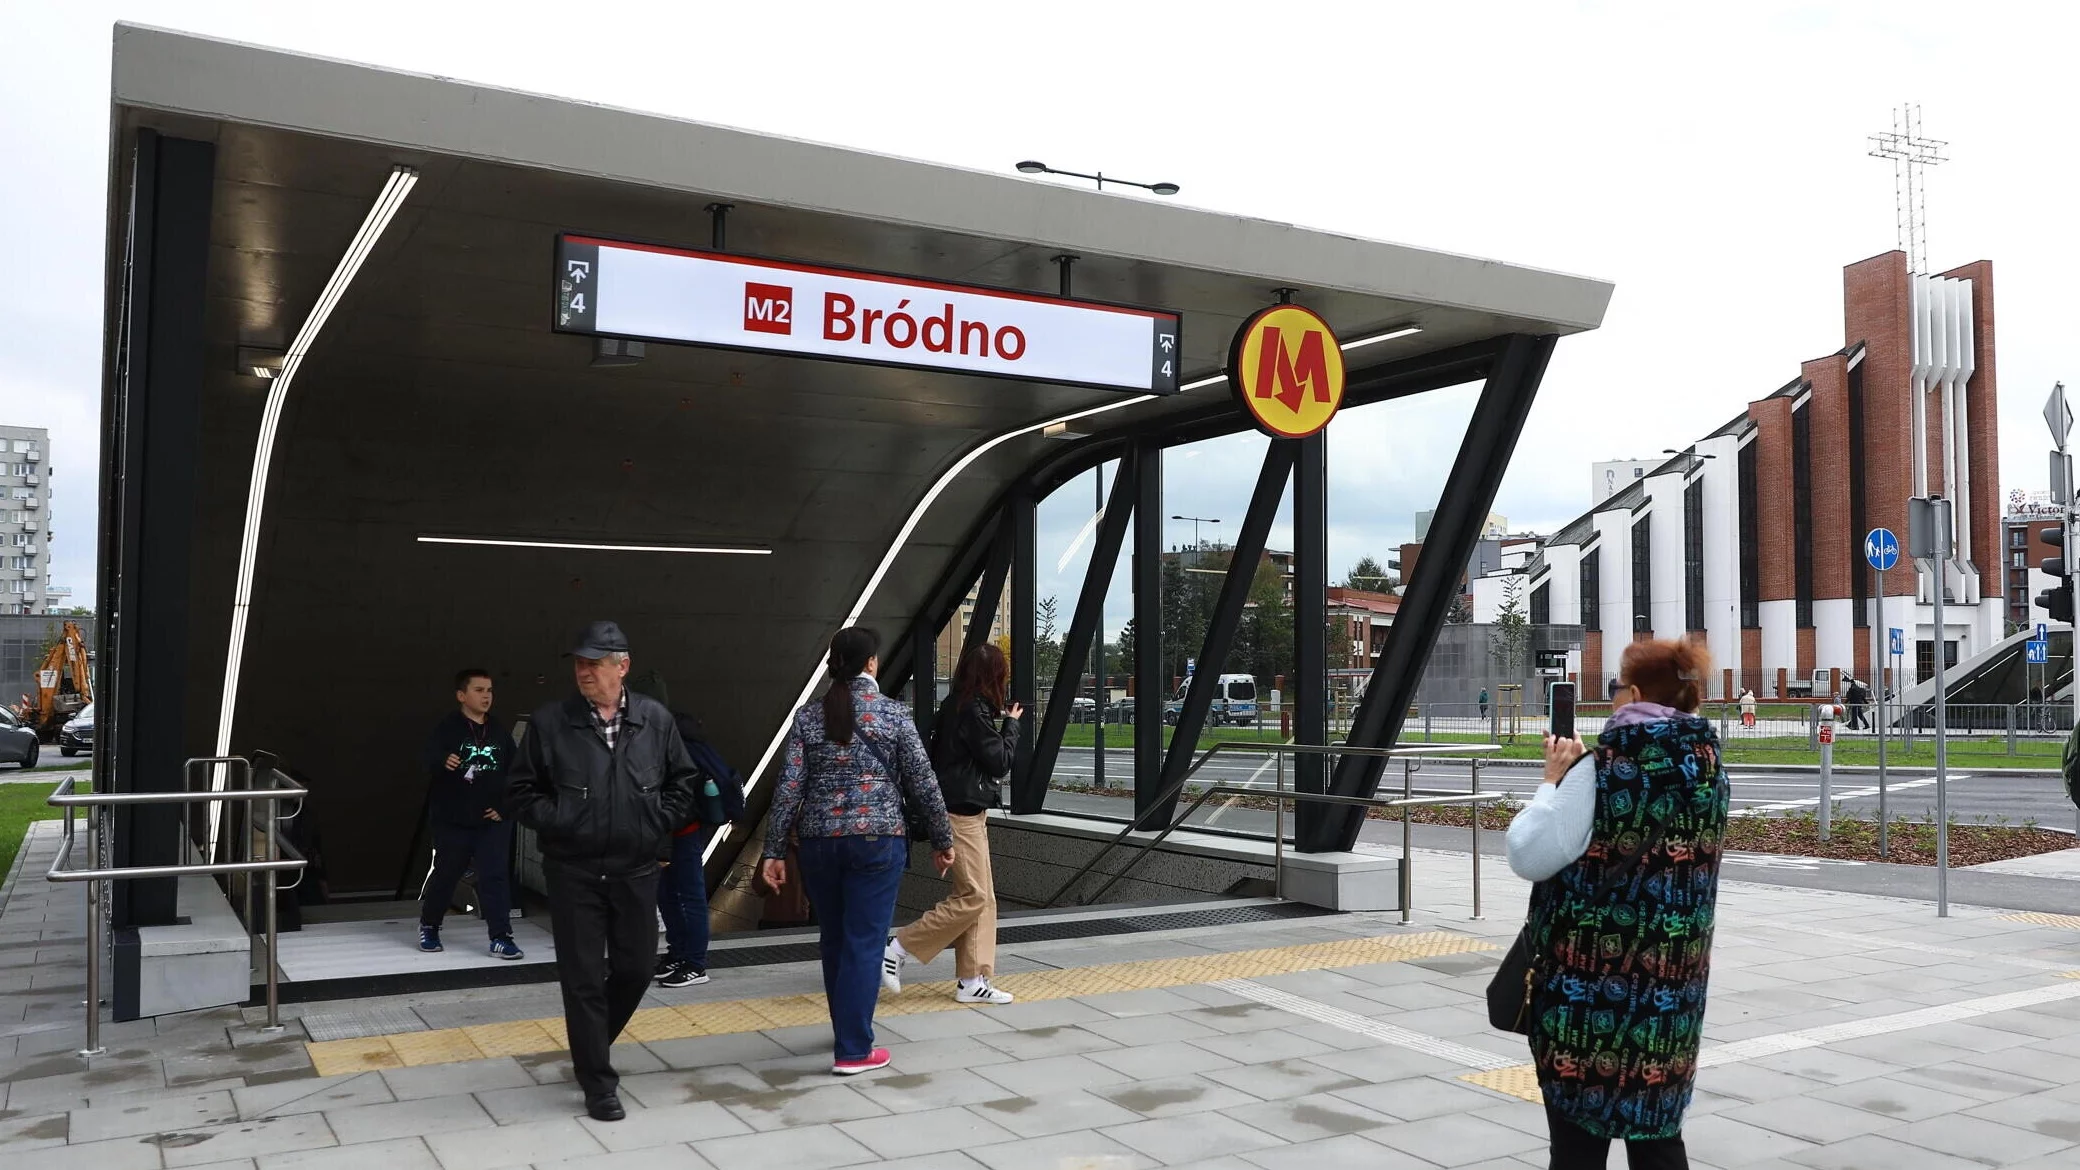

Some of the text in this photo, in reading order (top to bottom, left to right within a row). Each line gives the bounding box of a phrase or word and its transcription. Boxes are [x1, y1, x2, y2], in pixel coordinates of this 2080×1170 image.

[570, 292, 585, 314] 4
[748, 292, 1026, 361] M2 Bródno
[1161, 360, 1172, 378] 4
